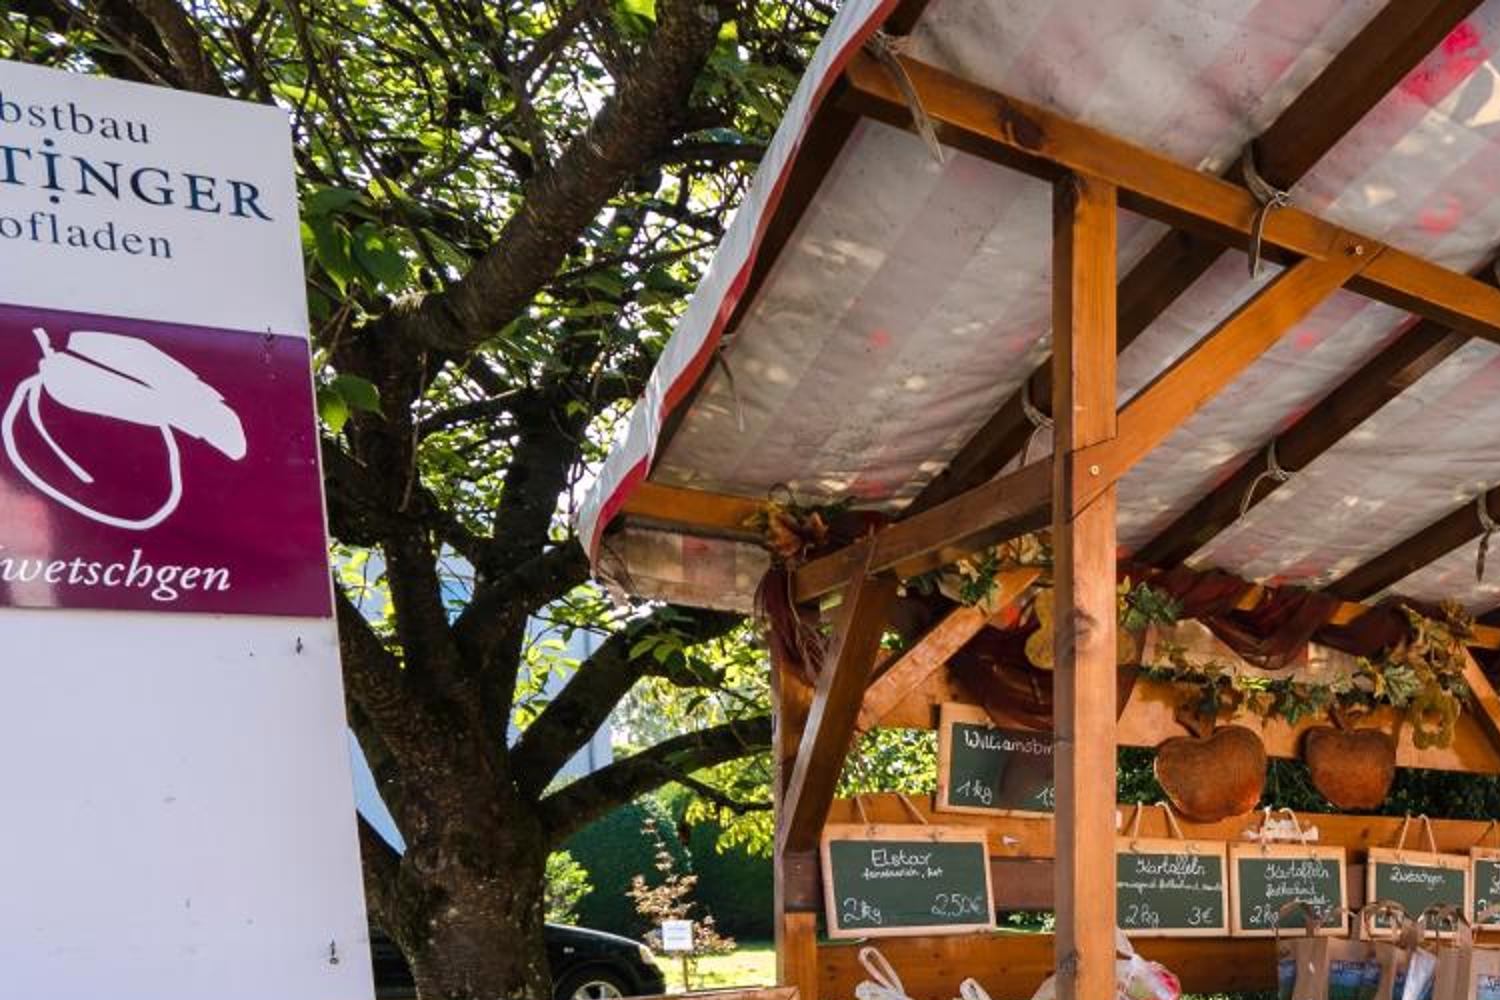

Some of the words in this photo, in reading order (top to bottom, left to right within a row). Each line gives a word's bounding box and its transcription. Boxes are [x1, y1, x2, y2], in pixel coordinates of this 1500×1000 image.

[870, 849, 932, 867] Elstar
[1135, 855, 1206, 876] Kartoffeln
[843, 897, 882, 925] 2kg
